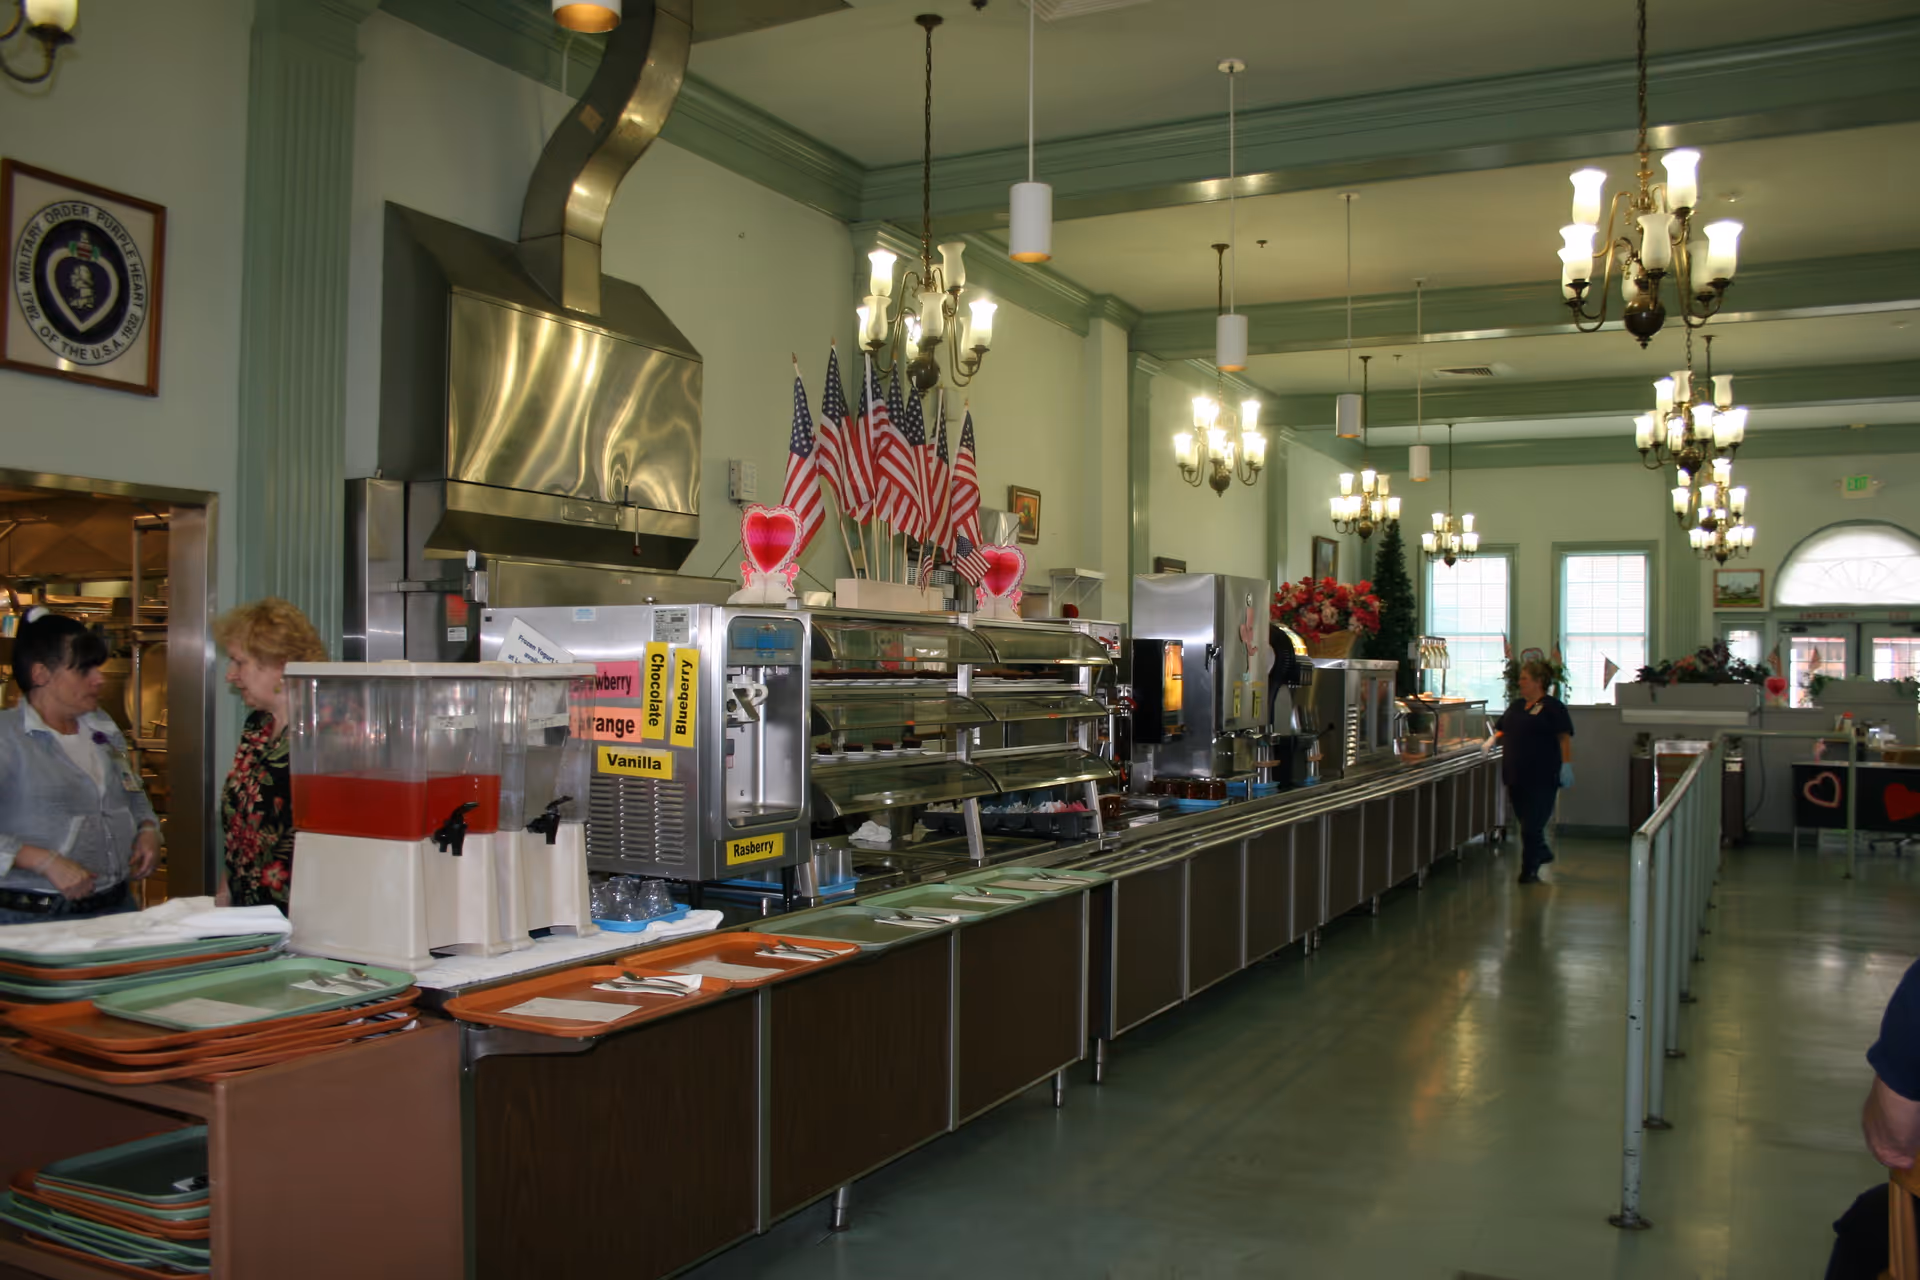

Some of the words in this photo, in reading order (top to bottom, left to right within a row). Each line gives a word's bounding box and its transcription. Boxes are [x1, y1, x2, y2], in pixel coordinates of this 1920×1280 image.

[19, 221, 43, 283] MILITARY
[44, 204, 90, 224] ORDER
[96, 210, 137, 259] PURPLE
[129, 263, 144, 308] HEART
[22, 290, 41, 321] 1782
[121, 313, 139, 339] 1932
[39, 325, 60, 344] OF
[61, 341, 88, 360] THE
[517, 634, 538, 651] Frozen
[649, 653, 665, 727] Chocolate
[675, 659, 693, 735] Blueberry
[607, 753, 662, 770] Vanilla
[733, 840, 774, 858] Rasberry
